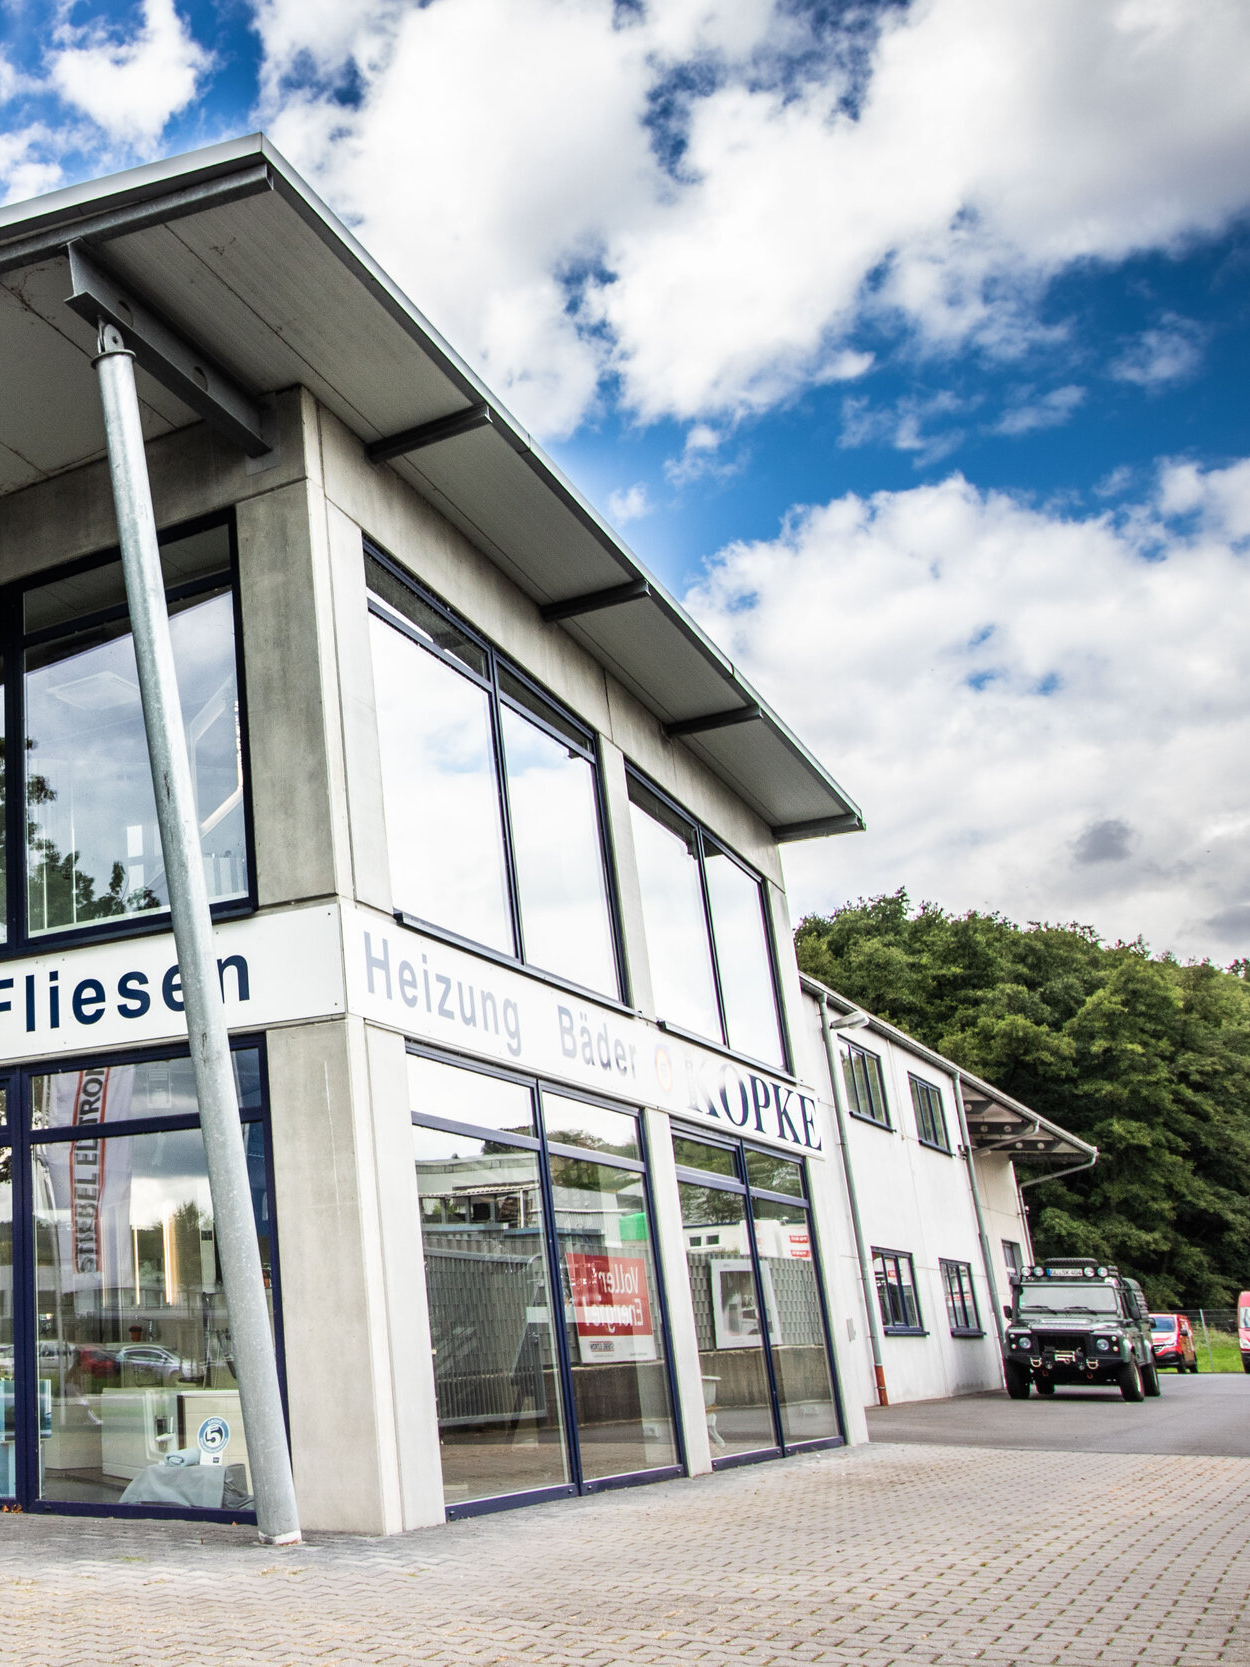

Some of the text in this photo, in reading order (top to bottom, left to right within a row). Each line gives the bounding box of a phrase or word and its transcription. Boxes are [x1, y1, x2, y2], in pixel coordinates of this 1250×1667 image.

[363, 930, 637, 1080] Heizung Bäder
[73, 1172, 99, 1274] STIEBEL
